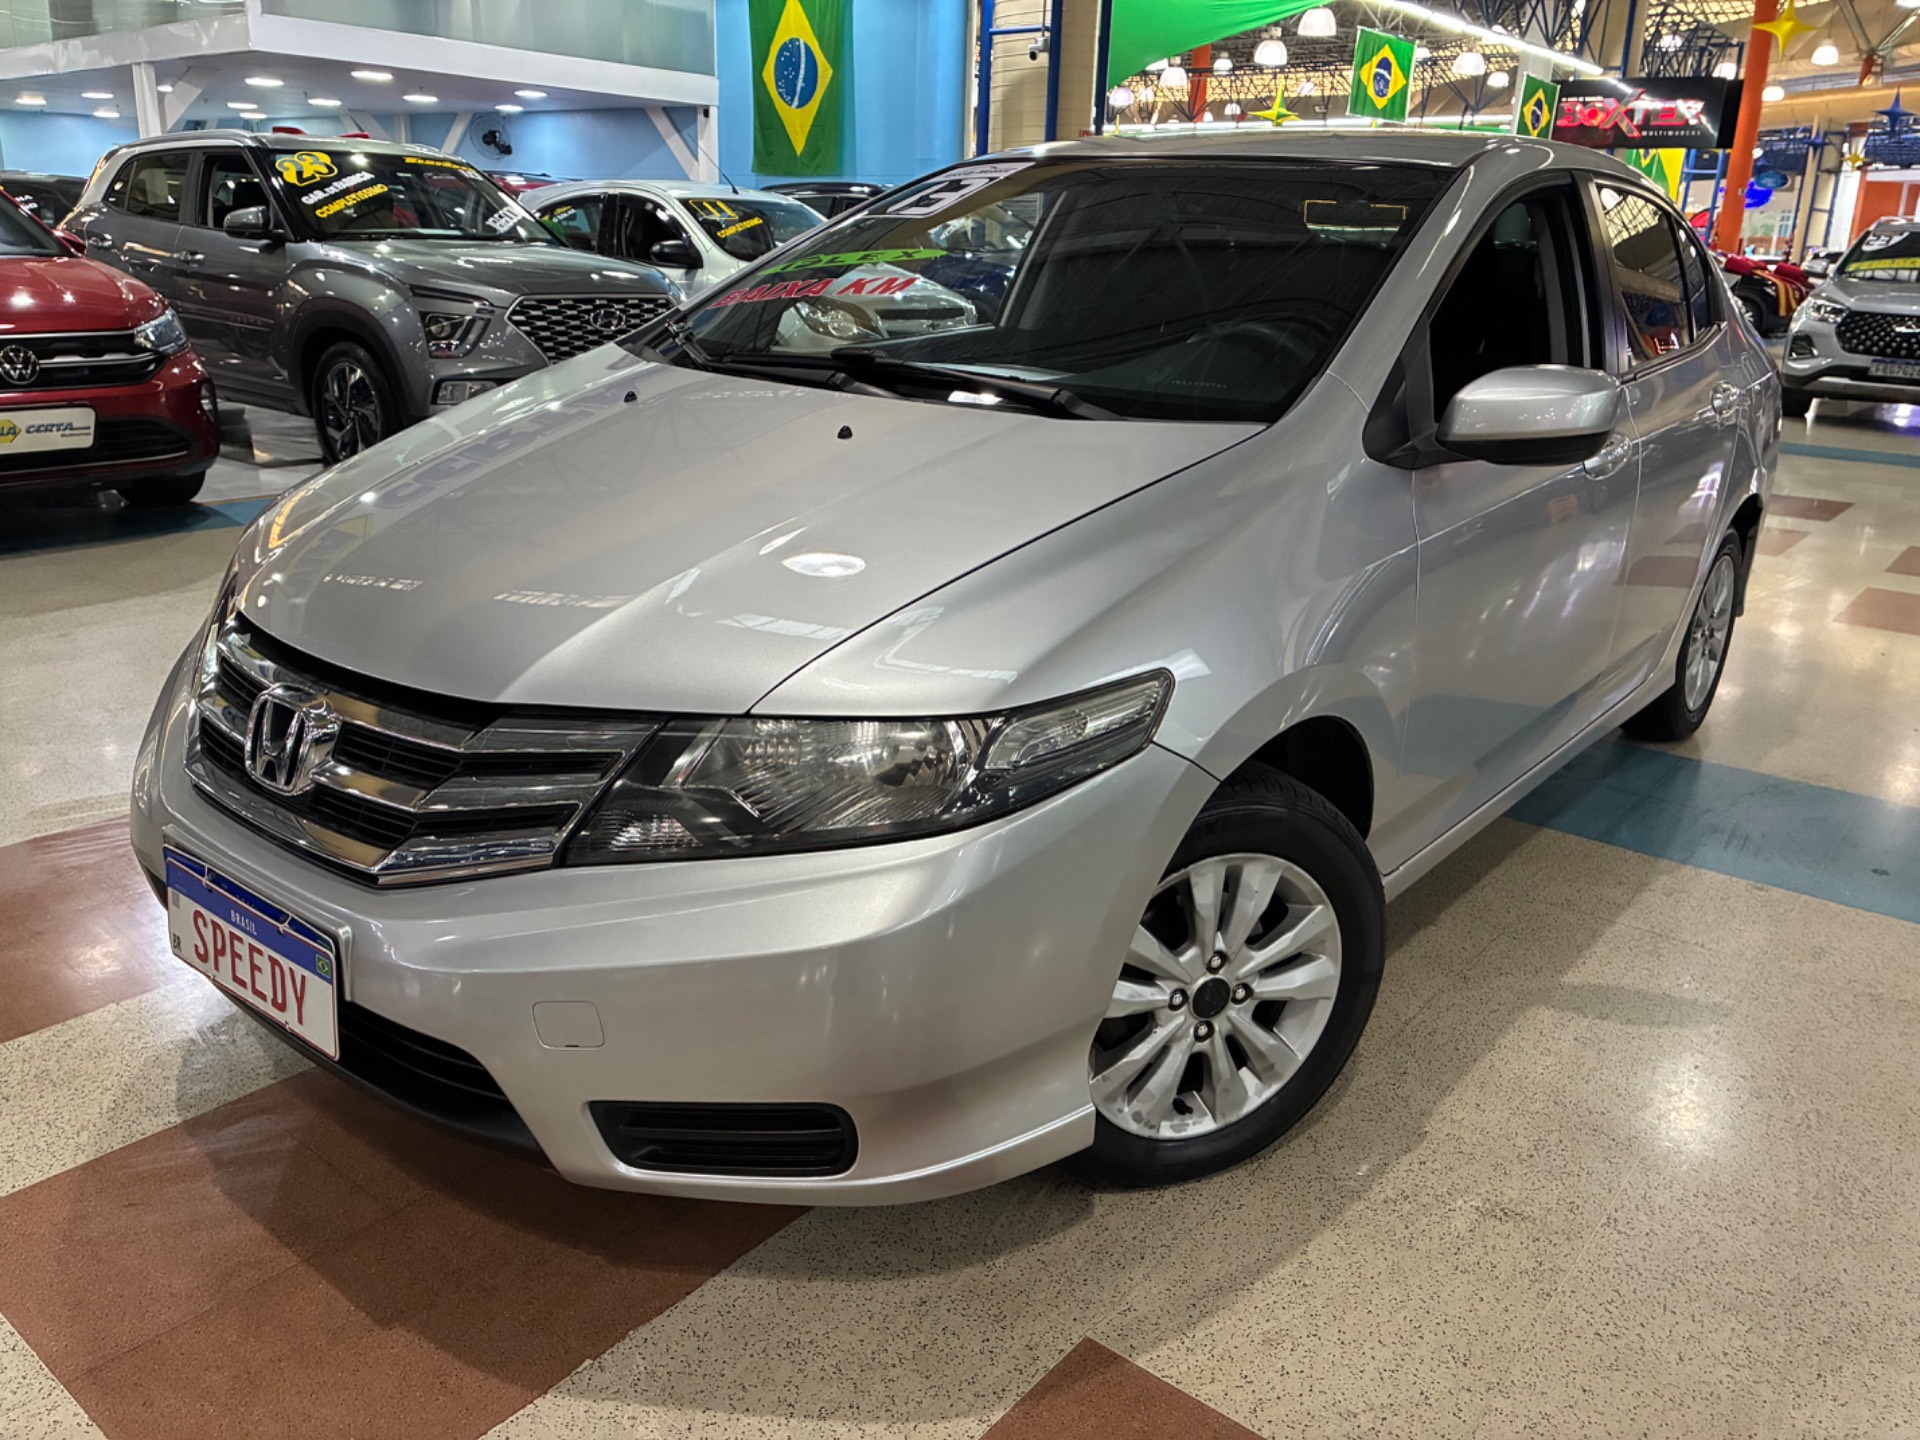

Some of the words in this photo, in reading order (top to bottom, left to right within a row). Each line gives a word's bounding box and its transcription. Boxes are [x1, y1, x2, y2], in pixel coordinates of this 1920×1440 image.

[1556, 88, 1705, 138] BOXTER
[275, 151, 339, 187] 23
[706, 278, 836, 309] BAIXA
[835, 277, 920, 295] KM
[230, 909, 258, 936] BRASIL
[171, 932, 182, 953] BR
[193, 909, 306, 1025] SPEEDY
